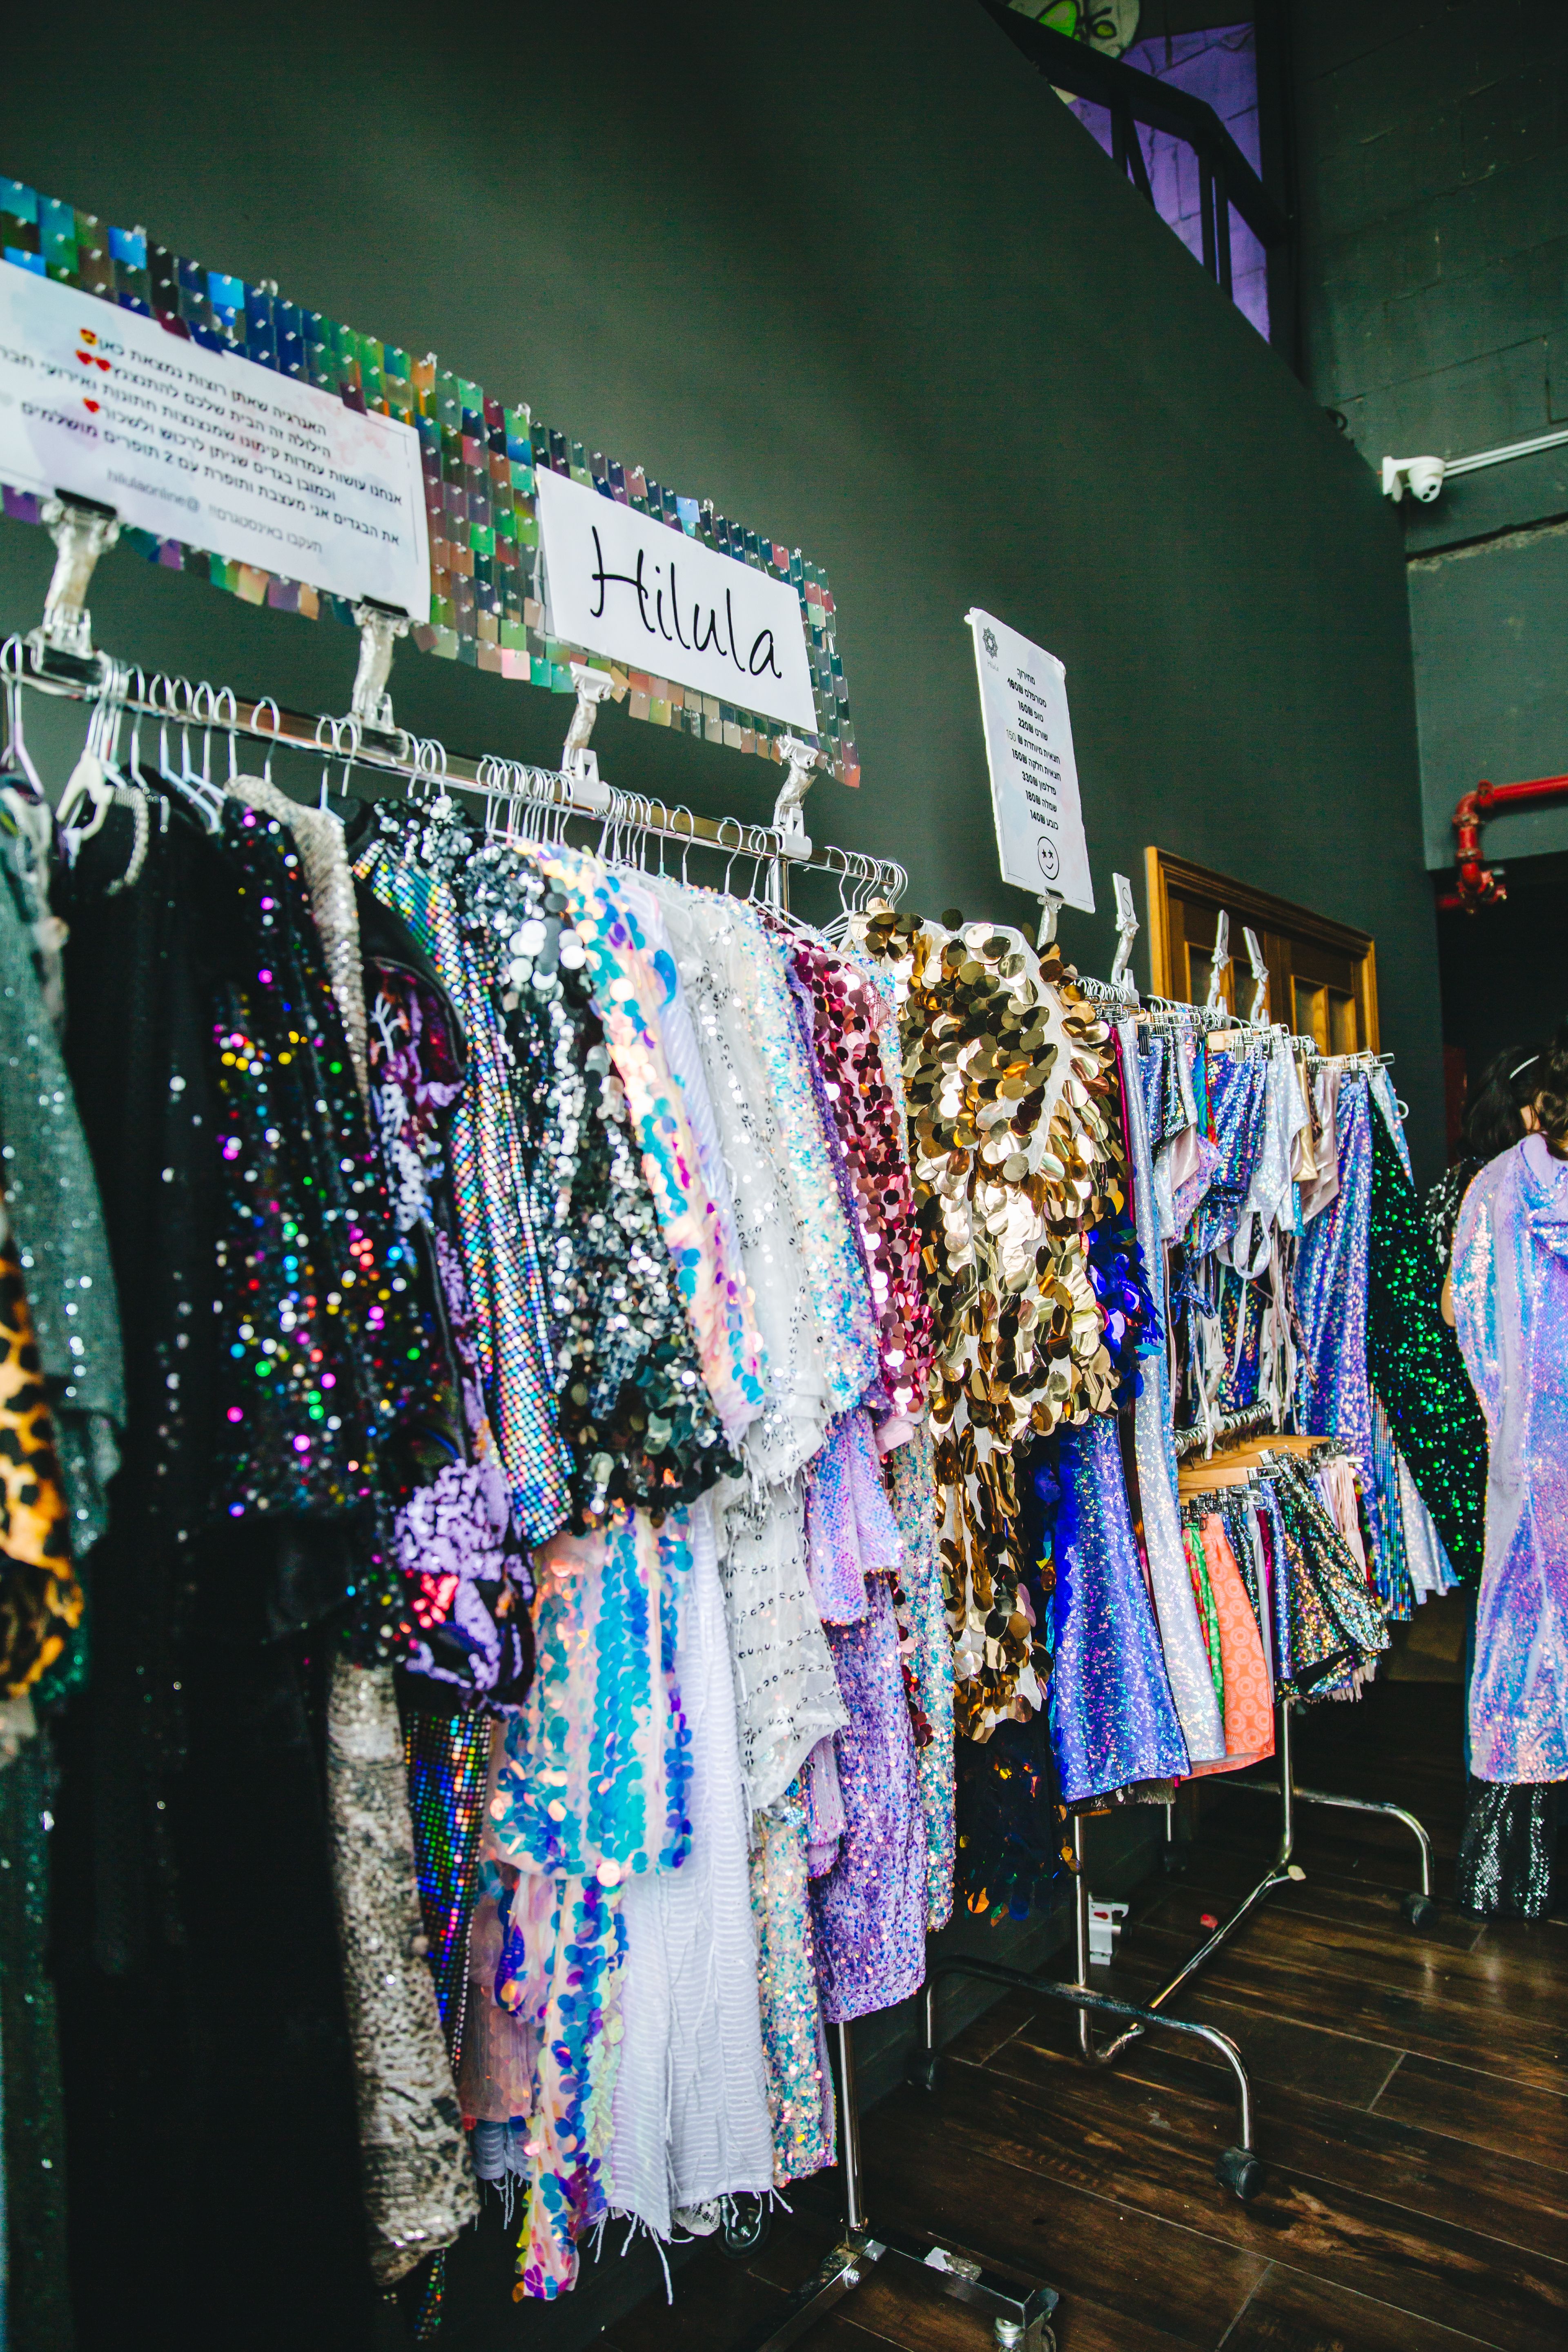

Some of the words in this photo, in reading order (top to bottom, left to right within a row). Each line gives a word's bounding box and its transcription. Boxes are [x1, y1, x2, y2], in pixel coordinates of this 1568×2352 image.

[100, 339, 124, 356] כאן
[131, 350, 182, 379] נמצאת
[189, 372, 227, 396] רוצות
[104, 384, 157, 412] חתונות
[232, 390, 267, 412] שאתן
[22, 401, 98, 438] מושלמים
[230, 409, 265, 432] הבית
[273, 406, 326, 436] האנרגיה
[160, 427, 204, 451] לרכוש
[270, 425, 283, 439] זה
[104, 430, 159, 459] תופרים
[288, 433, 330, 458] הילולה
[164, 451, 173, 464] 2
[179, 457, 198, 471] עם
[210, 445, 248, 468] שניתן
[284, 452, 325, 474] עמדות
[204, 467, 253, 492] ותופרת
[254, 462, 293, 485] בגדים
[330, 469, 366, 490] עושות
[258, 485, 305, 511] מעצבת
[297, 478, 336, 501] וכמובן
[370, 484, 401, 506] אנחנו
[310, 504, 329, 520] אני
[334, 512, 378, 537] הבגדים
[382, 530, 399, 546] את
[590, 525, 782, 679] Hilula
[987, 659, 999, 672] Hilula
[1025, 688, 1047, 708] סטרפלס
[1034, 710, 1044, 722] טופ
[1006, 729, 1016, 742] 150
[1035, 727, 1048, 741] שורט
[1024, 739, 1043, 756] מיוחדת
[1043, 749, 1060, 764] חצאית
[1028, 758, 1044, 773] חלקה
[1044, 766, 1061, 782] חצאית
[1042, 799, 1057, 812] שמלה
[1046, 818, 1058, 830] כובע
[1122, 887, 1131, 917] S
[1210, 1325, 1222, 1349] M
